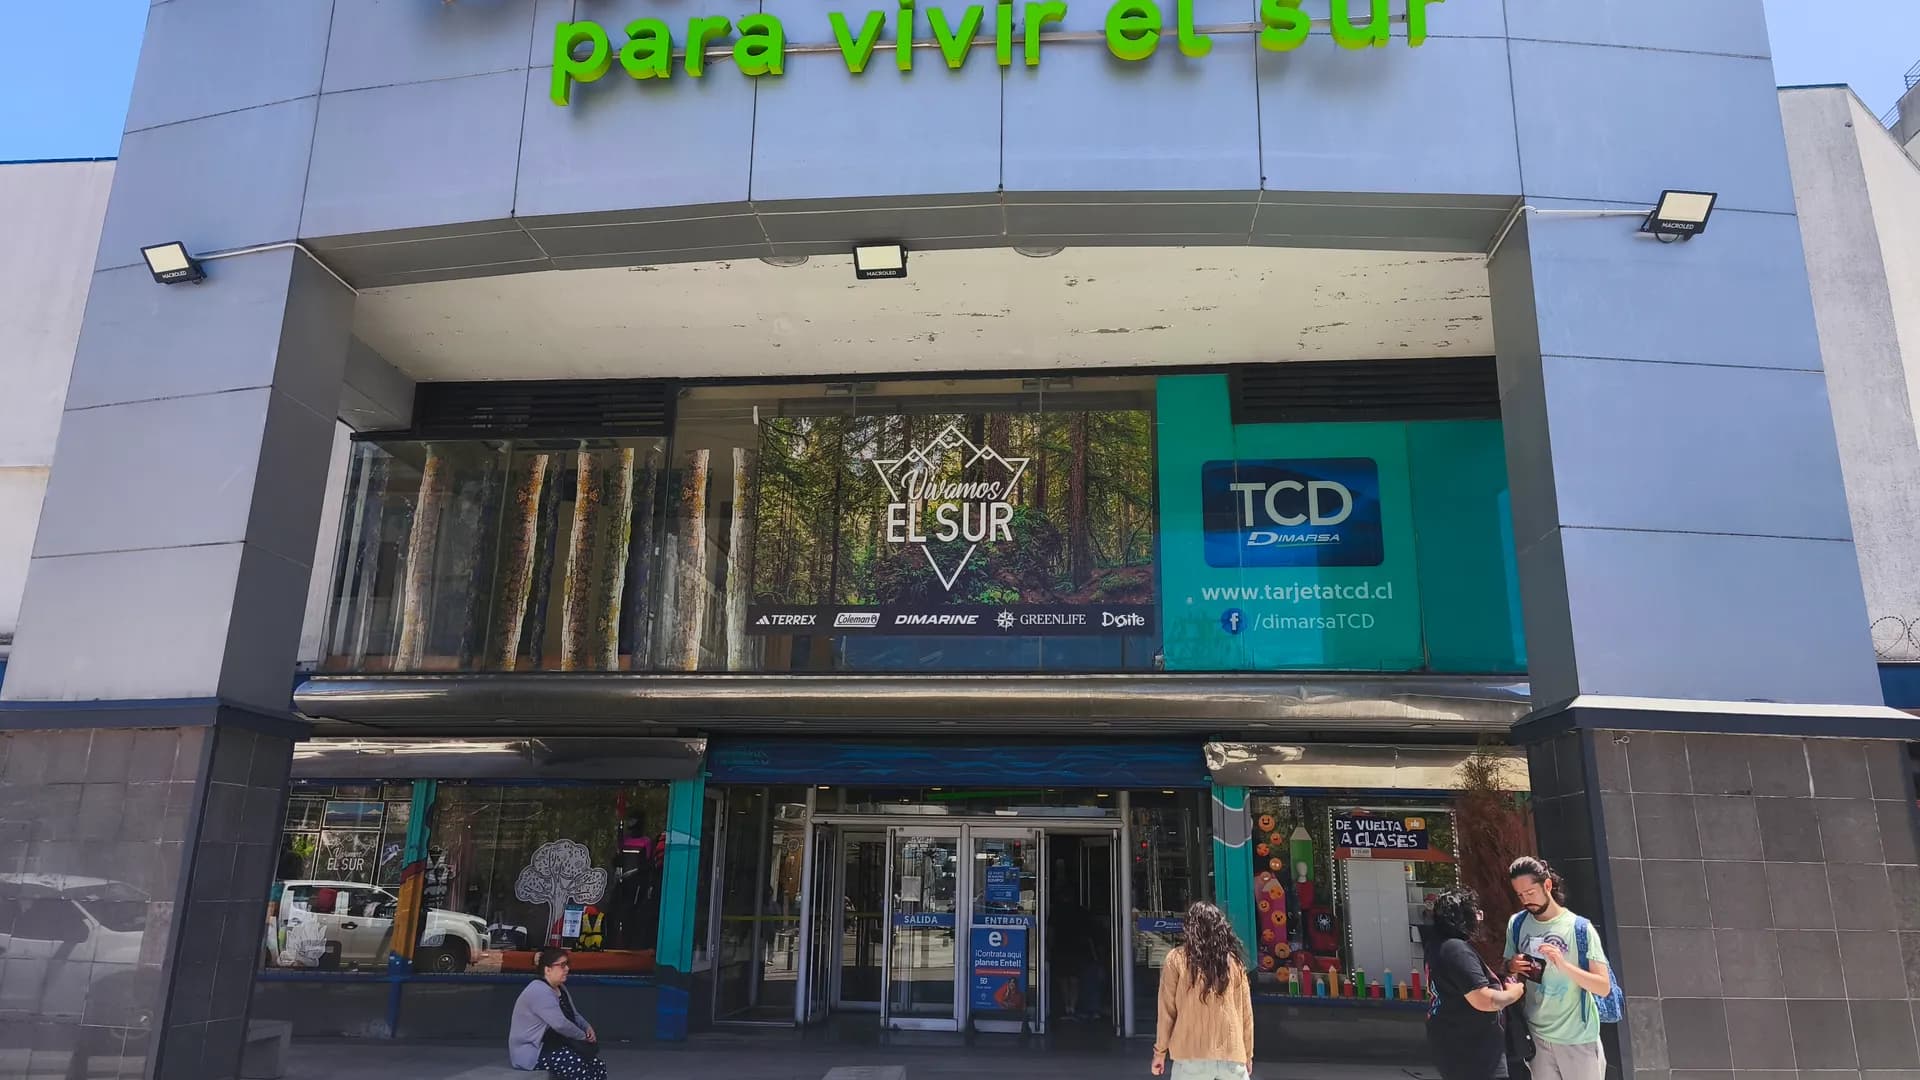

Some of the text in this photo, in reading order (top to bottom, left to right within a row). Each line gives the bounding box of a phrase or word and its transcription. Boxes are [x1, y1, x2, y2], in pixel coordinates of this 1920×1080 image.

[550, 0, 1446, 106] para vivir el sur
[1662, 221, 1694, 230] MACROLED
[901, 467, 1004, 501] Vivamos
[1229, 479, 1354, 528] TCD
[887, 502, 1014, 543] EL SUR
[1202, 581, 1393, 604] www.tarjetatcd.cl
[771, 614, 817, 625] TERREX
[837, 614, 870, 625] Coleman
[894, 614, 980, 626] DIMARINE
[1020, 614, 1087, 625] GREENLIFE
[1253, 612, 1375, 632] /dimarsaTCD
[1335, 820, 1353, 831] DE
[1355, 820, 1403, 832] VUELTA
[1340, 832, 1418, 848] A CLASES
[327, 857, 365, 871] EL SUR
[903, 915, 938, 924] SALIDA
[984, 916, 1030, 925] ENTRADA
